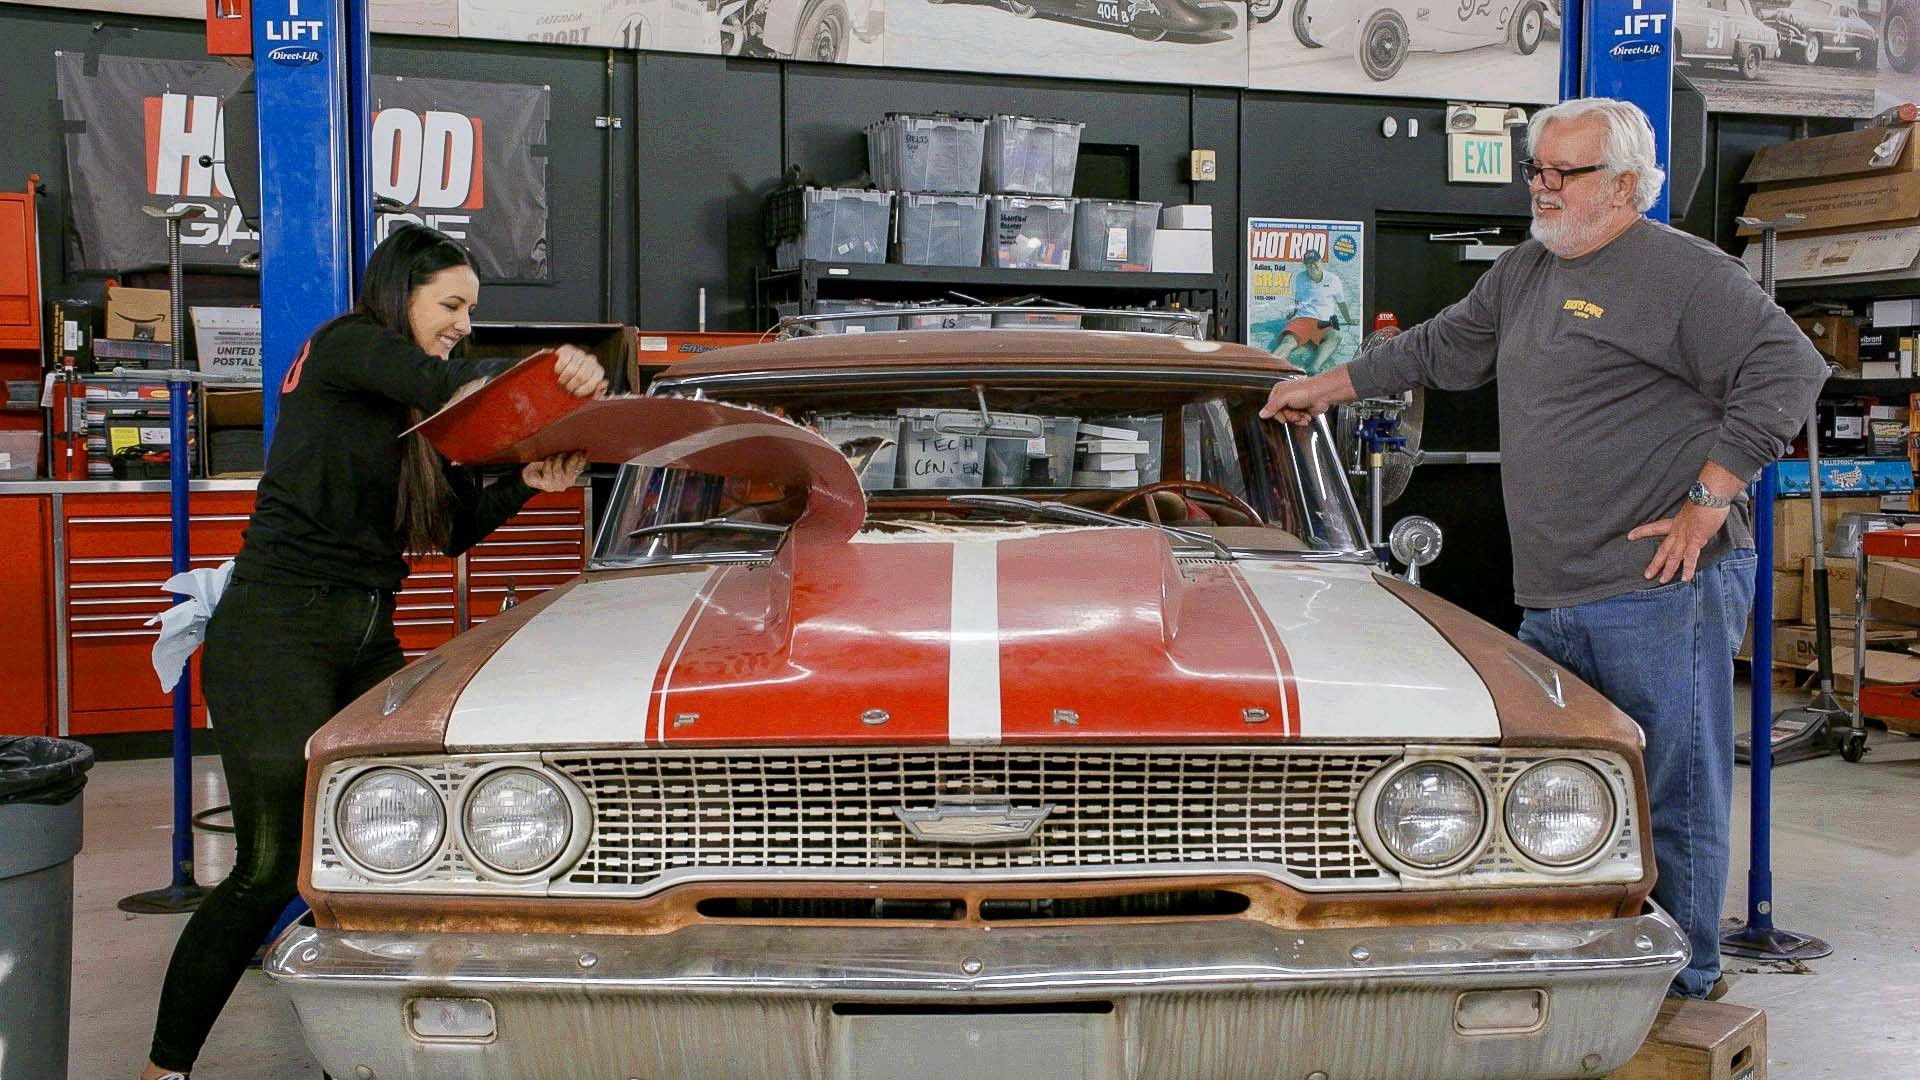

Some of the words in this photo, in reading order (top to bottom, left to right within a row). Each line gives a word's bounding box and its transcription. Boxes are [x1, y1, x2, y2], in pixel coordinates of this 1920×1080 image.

[1097, 3, 1119, 21] 404
[266, 20, 324, 41] LIFT
[1614, 14, 1667, 36] IFT
[272, 51, 320, 62] Direct-Lift
[1613, 44, 1661, 56] Direct-Lift
[1464, 140, 1504, 175] EXIT
[1252, 231, 1289, 259] HOT
[1289, 232, 1328, 261] ROD
[1254, 264, 1273, 273] Adios,
[216, 346, 256, 356] UNITED
[212, 357, 255, 367] POSTAL
[917, 437, 973, 452] TECH
